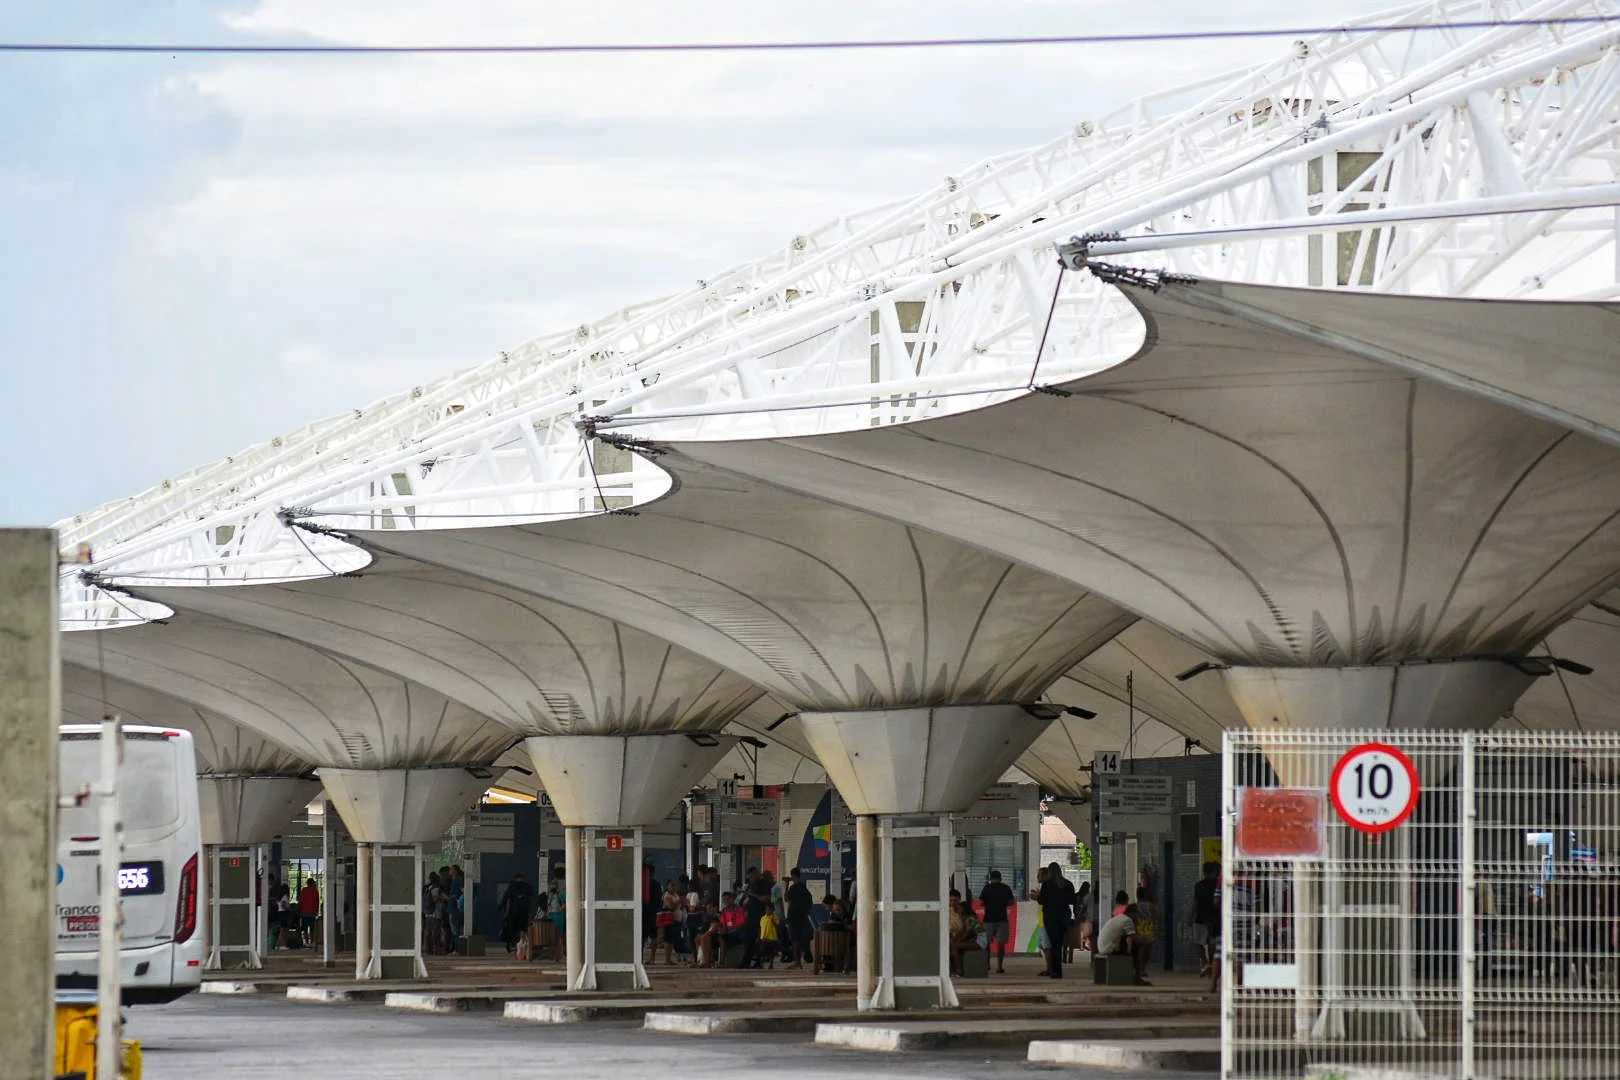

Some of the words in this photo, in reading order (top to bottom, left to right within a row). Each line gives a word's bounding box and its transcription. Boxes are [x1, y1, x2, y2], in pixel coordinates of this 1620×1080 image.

[1101, 753, 1117, 771] 14
[722, 780, 734, 795] 11
[1354, 763, 1393, 799] 10
[118, 866, 149, 889] 656
[55, 904, 101, 916] Transco
